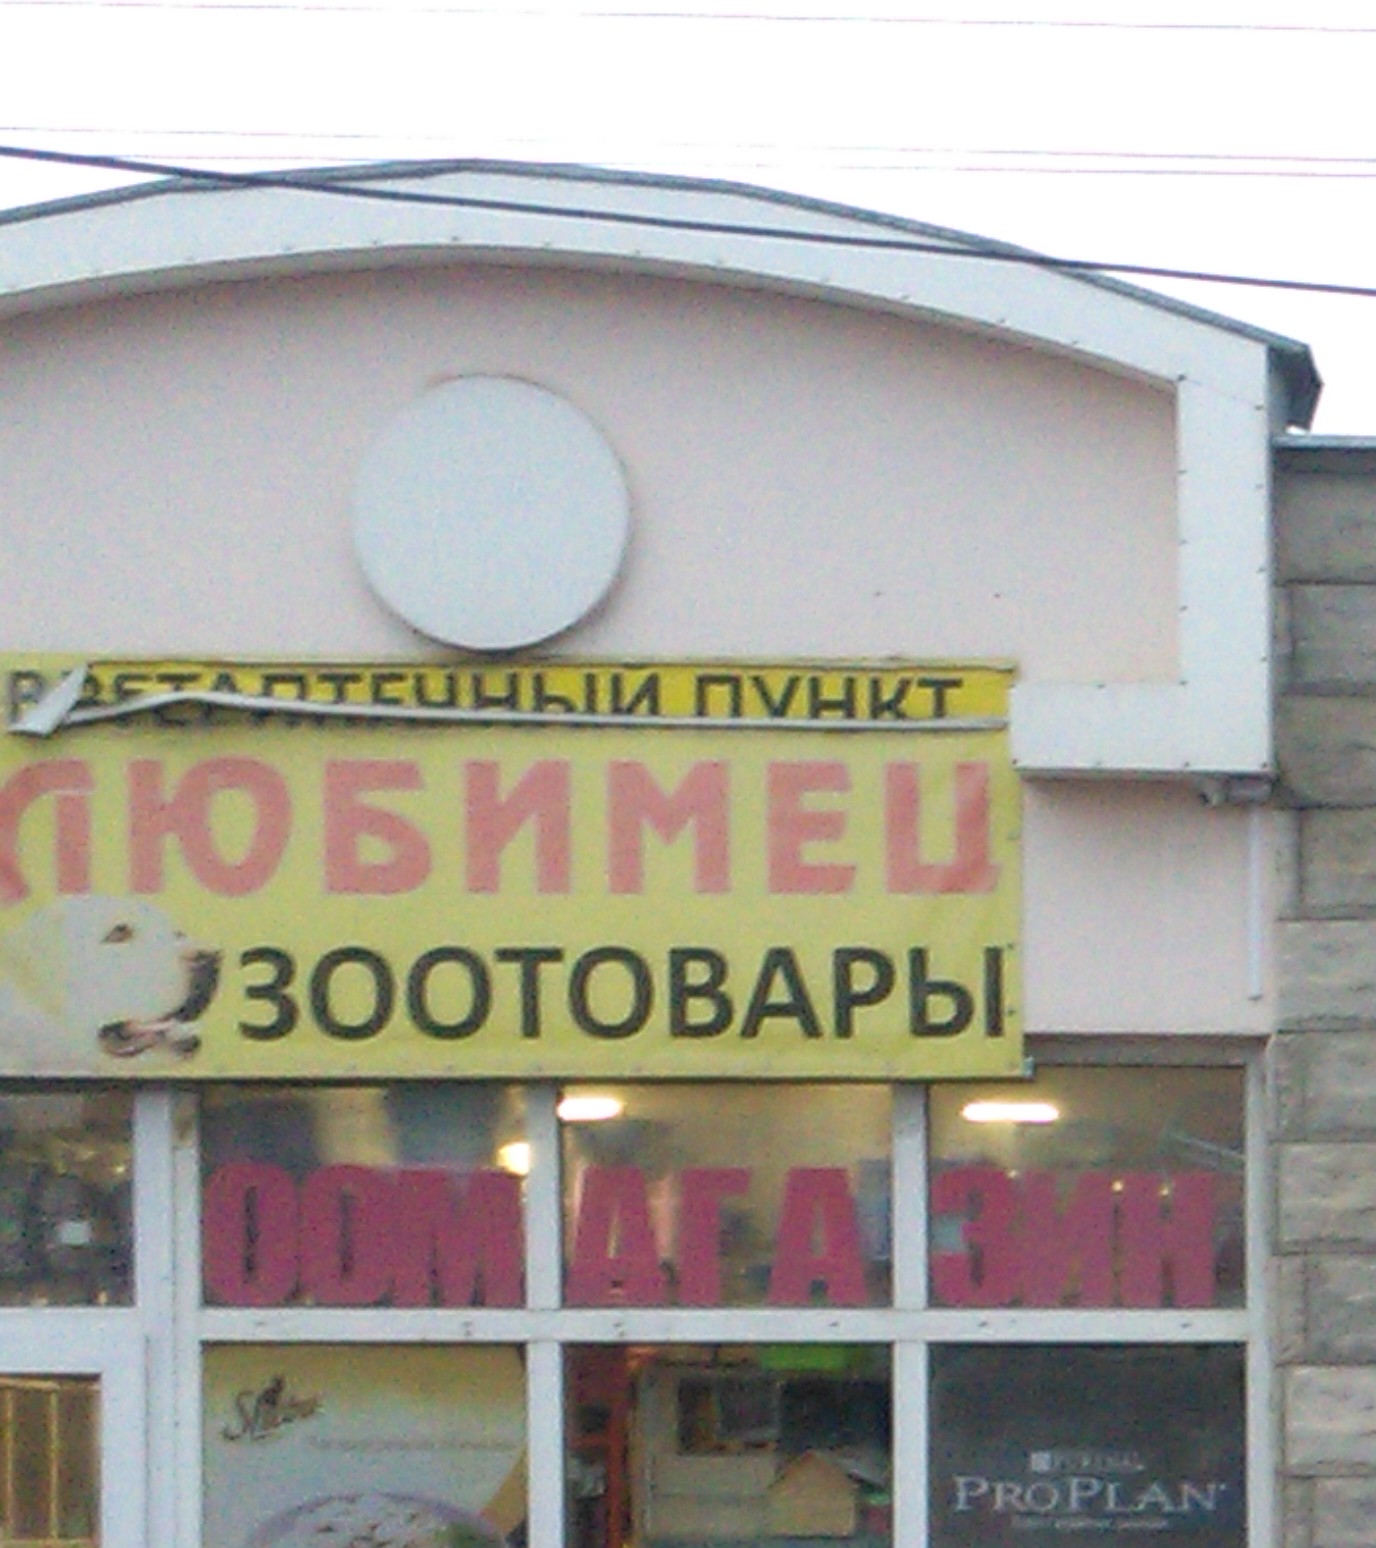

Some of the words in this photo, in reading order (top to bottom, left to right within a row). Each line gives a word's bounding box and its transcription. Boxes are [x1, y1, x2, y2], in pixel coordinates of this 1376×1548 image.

[695, 674, 963, 720] ПУНКТ
[0, 757, 1002, 906] ЛЮБИМЕЦ
[237, 944, 1004, 1042] ЗООТОВАРЫ
